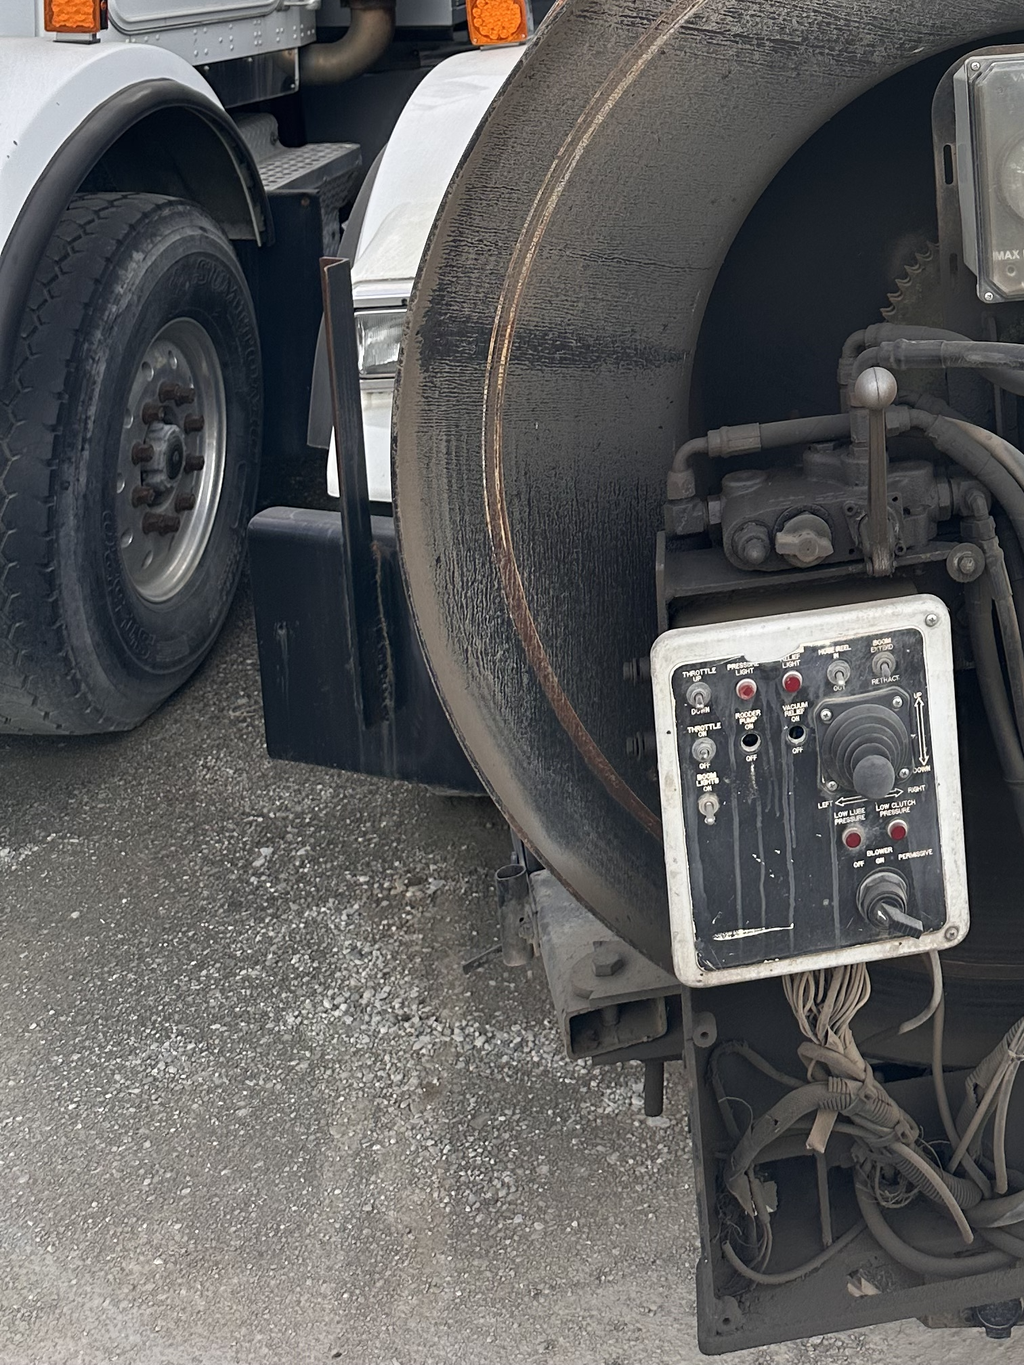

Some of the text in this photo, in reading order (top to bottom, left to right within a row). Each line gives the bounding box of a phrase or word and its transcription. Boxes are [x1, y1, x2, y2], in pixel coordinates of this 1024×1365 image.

[782, 659, 801, 669] LIGHT
[682, 667, 717, 678] THROTTLE
[735, 667, 755, 676] LIGHT
[872, 675, 900, 685] RETRACT
[782, 701, 808, 711] VACUUM
[790, 715, 800, 723] ON
[687, 722, 722, 734] THROTTLE
[791, 746, 803, 754] OFF
[745, 754, 757, 762] OFF
[913, 765, 931, 774] DOWN
[907, 784, 926, 794] RIGHT
[817, 800, 834, 809] LEFT
[875, 799, 916, 812] LOW CLUTCH
[833, 807, 866, 819] LOW LUBE
[879, 806, 911, 817] PRESSURE
[834, 814, 866, 826] PRESSURE
[866, 846, 893, 857] BLOWER
[898, 848, 933, 860] PERMISSIVE
[853, 860, 865, 868] OFF
